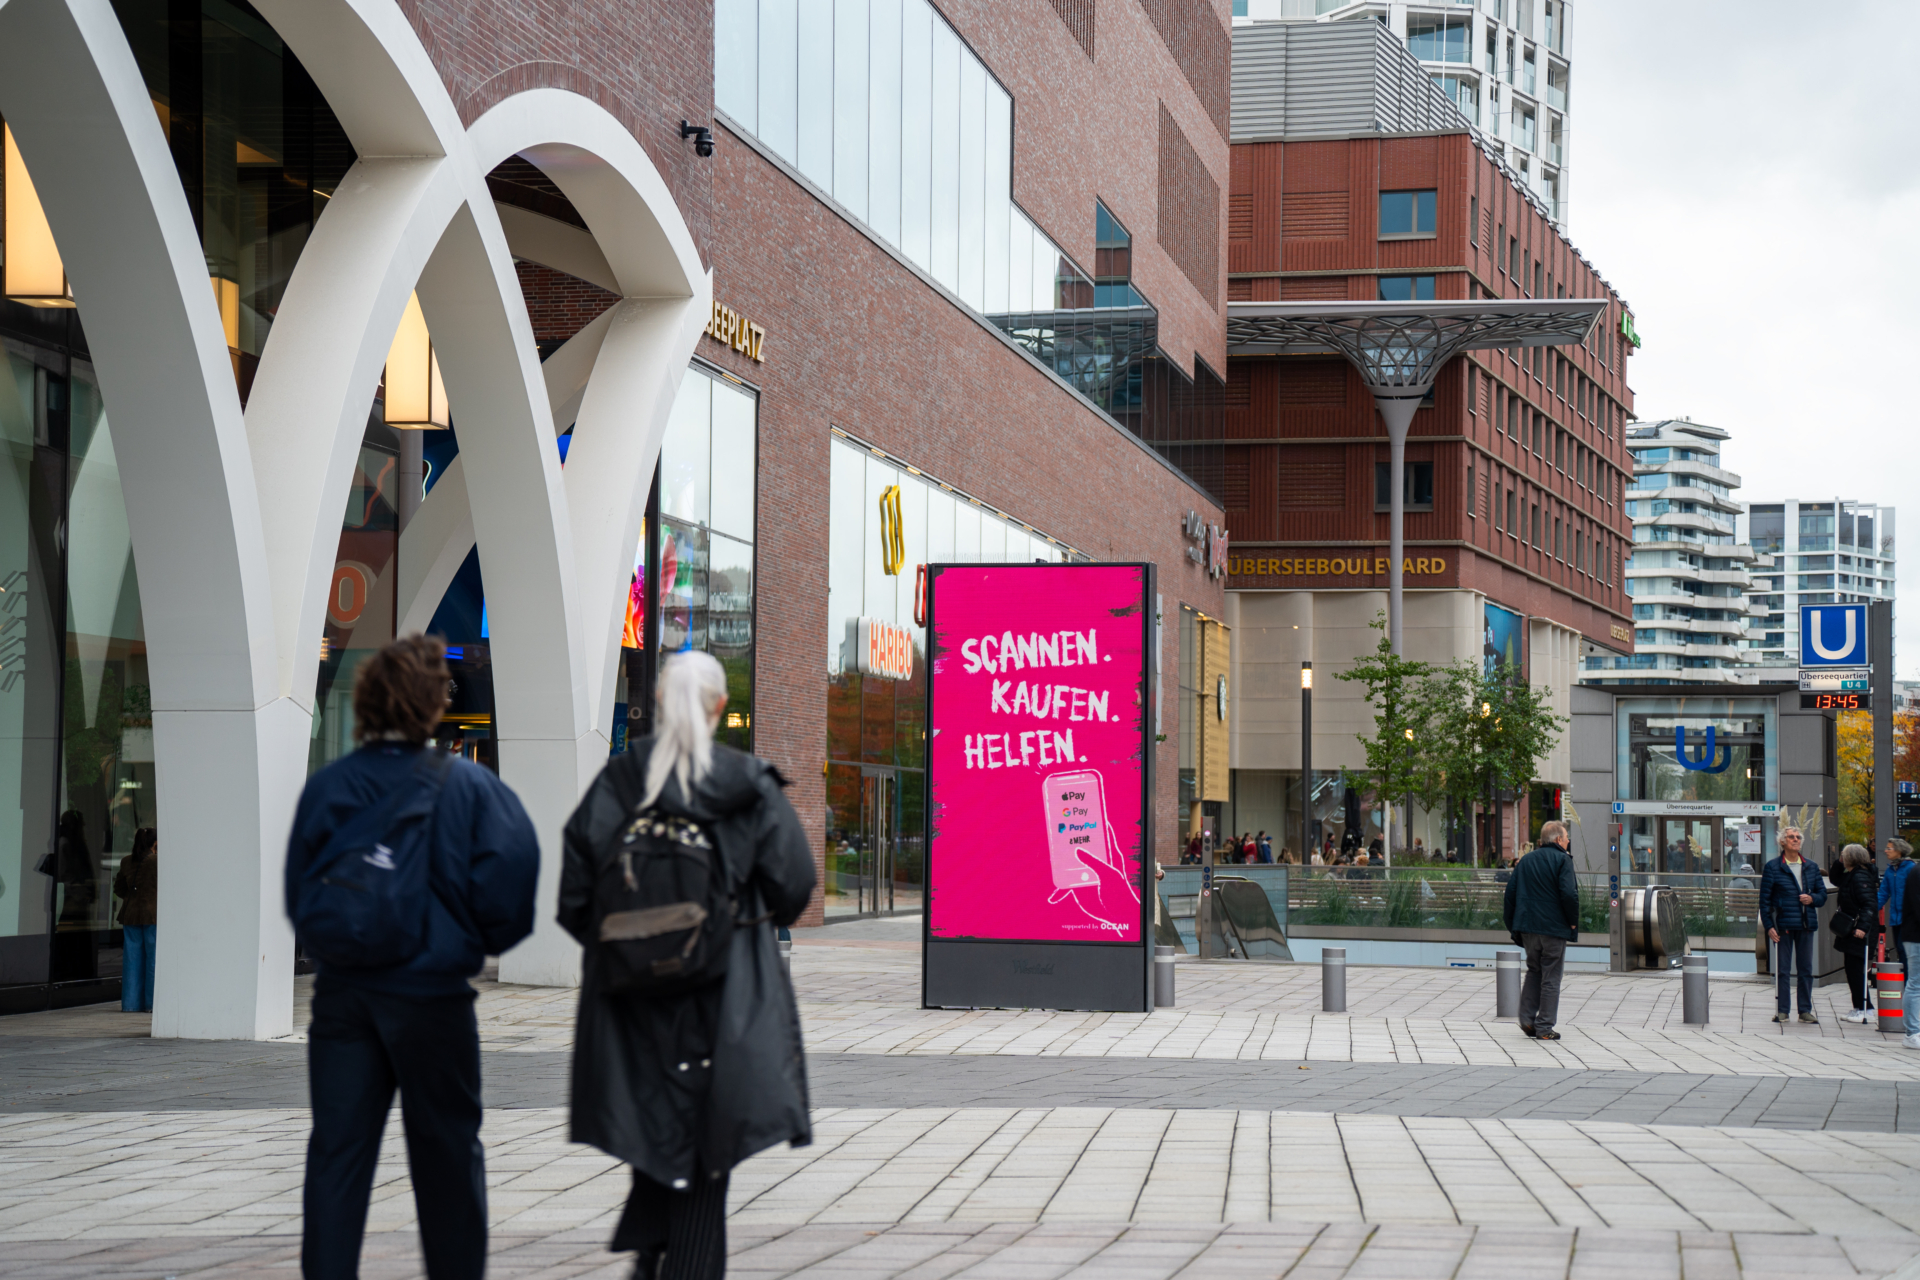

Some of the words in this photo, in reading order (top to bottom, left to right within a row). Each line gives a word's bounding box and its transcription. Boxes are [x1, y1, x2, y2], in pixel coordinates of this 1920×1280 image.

[1811, 609, 1856, 660] U
[869, 620, 912, 677] HARIBO
[961, 628, 1112, 674] SCANNEN.
[1800, 672, 1868, 681] Überseequartier
[991, 678, 1120, 722] KAUFEN.
[1816, 695, 1858, 709] 13:45
[964, 728, 1088, 769] HELFEN.
[1676, 726, 1715, 770] U
[1069, 792, 1085, 801] Pay
[1073, 807, 1088, 816] Pay
[1614, 803, 1623, 812] U
[1666, 803, 1713, 811] Überseequartier
[1069, 821, 1097, 831] PayPal
[1092, 923, 1099, 931] by
[1013, 959, 1055, 976] Westfield
